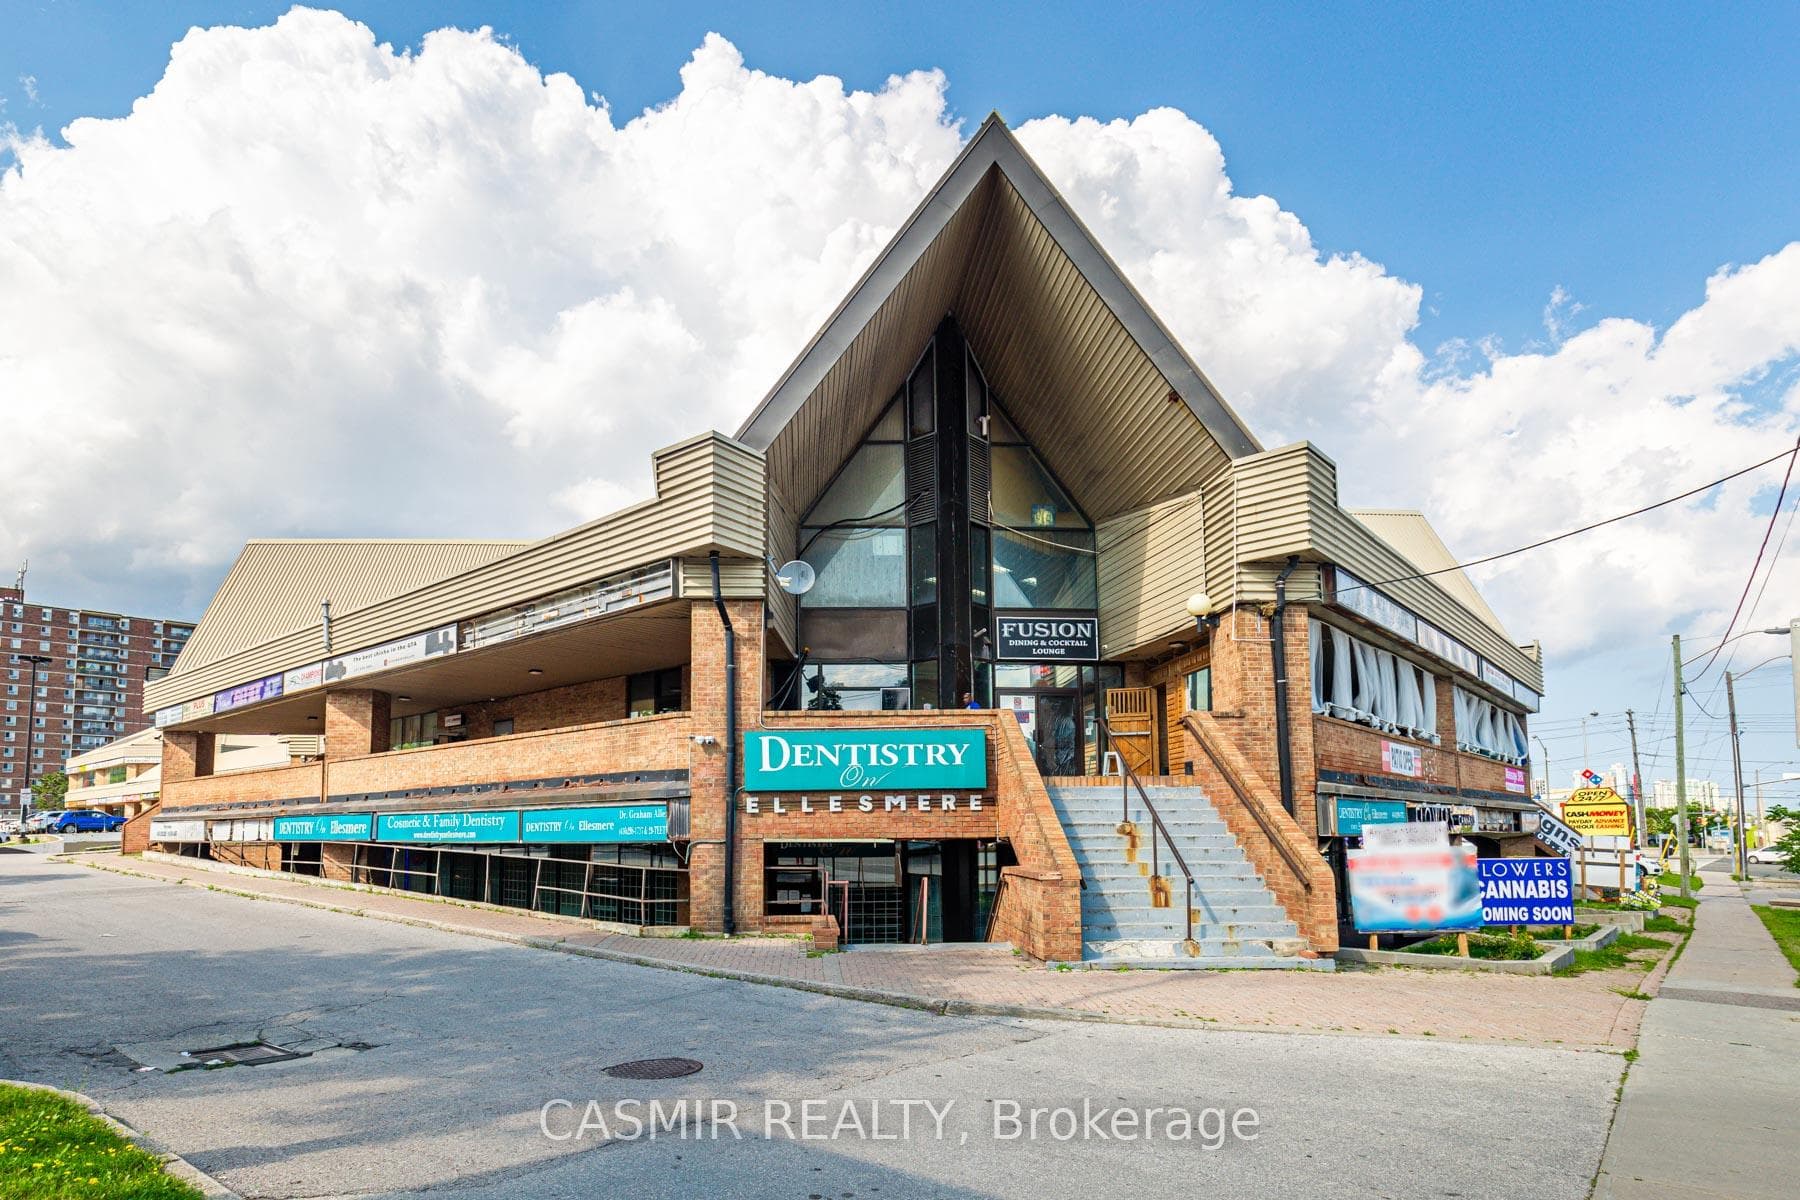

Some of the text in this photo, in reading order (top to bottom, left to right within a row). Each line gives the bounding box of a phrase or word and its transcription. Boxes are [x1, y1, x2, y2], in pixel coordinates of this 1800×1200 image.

[1001, 622, 1092, 638] FUSION
[1048, 639, 1088, 647] COCKTAIL
[362, 653, 373, 661] best
[397, 644, 406, 652] the
[758, 735, 970, 772] DENTISTRY
[839, 764, 895, 788] On
[746, 794, 983, 814] ELLESMERE
[387, 811, 506, 831] Cosmetic & Family Dentistry
[619, 808, 628, 819] Dr.
[629, 808, 652, 819] Graham
[279, 820, 314, 834] DENTISTRY
[330, 820, 367, 834] Ellesmere
[526, 821, 562, 833] DENTISTRY
[578, 819, 615, 831] Ellesmere
[1482, 862, 1568, 877] LOWERS
[1482, 906, 1573, 921] OMING SOON
